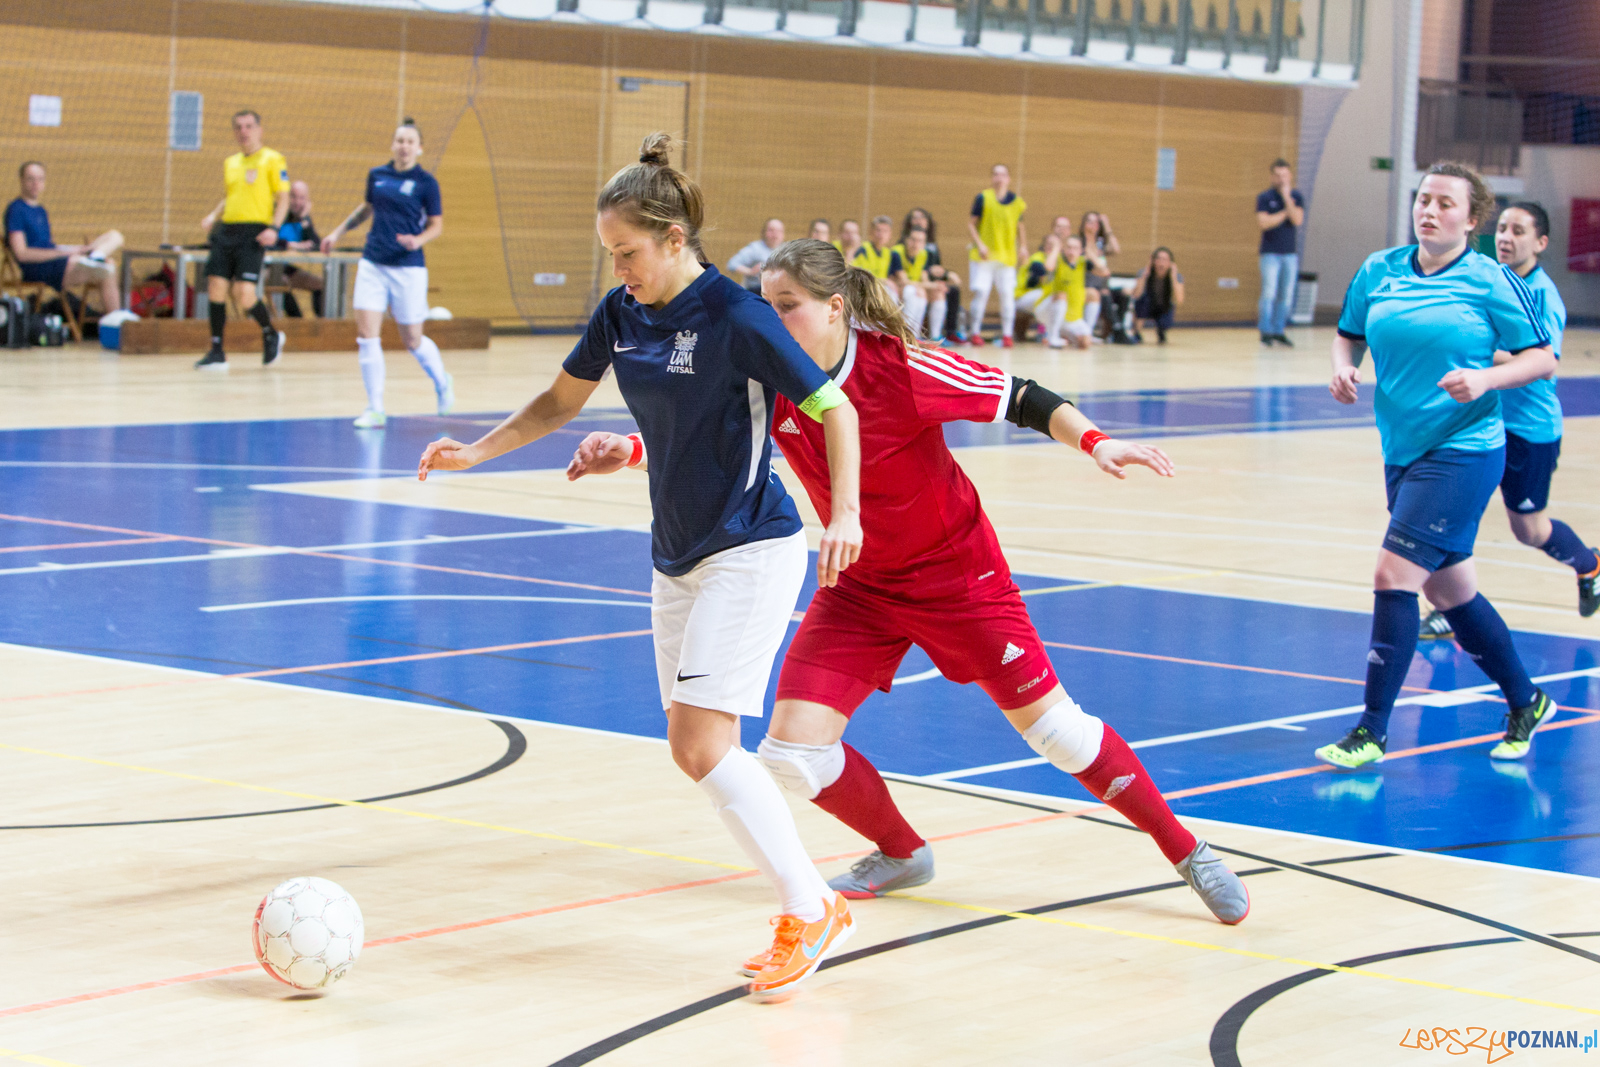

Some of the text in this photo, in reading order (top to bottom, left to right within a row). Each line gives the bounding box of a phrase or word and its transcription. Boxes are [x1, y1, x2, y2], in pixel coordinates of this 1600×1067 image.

[669, 350, 693, 367] UAM
[666, 365, 695, 375] FUTSAL
[778, 426, 801, 435] adidas
[1001, 648, 1026, 665] adidas
[1017, 668, 1049, 694] COLO
